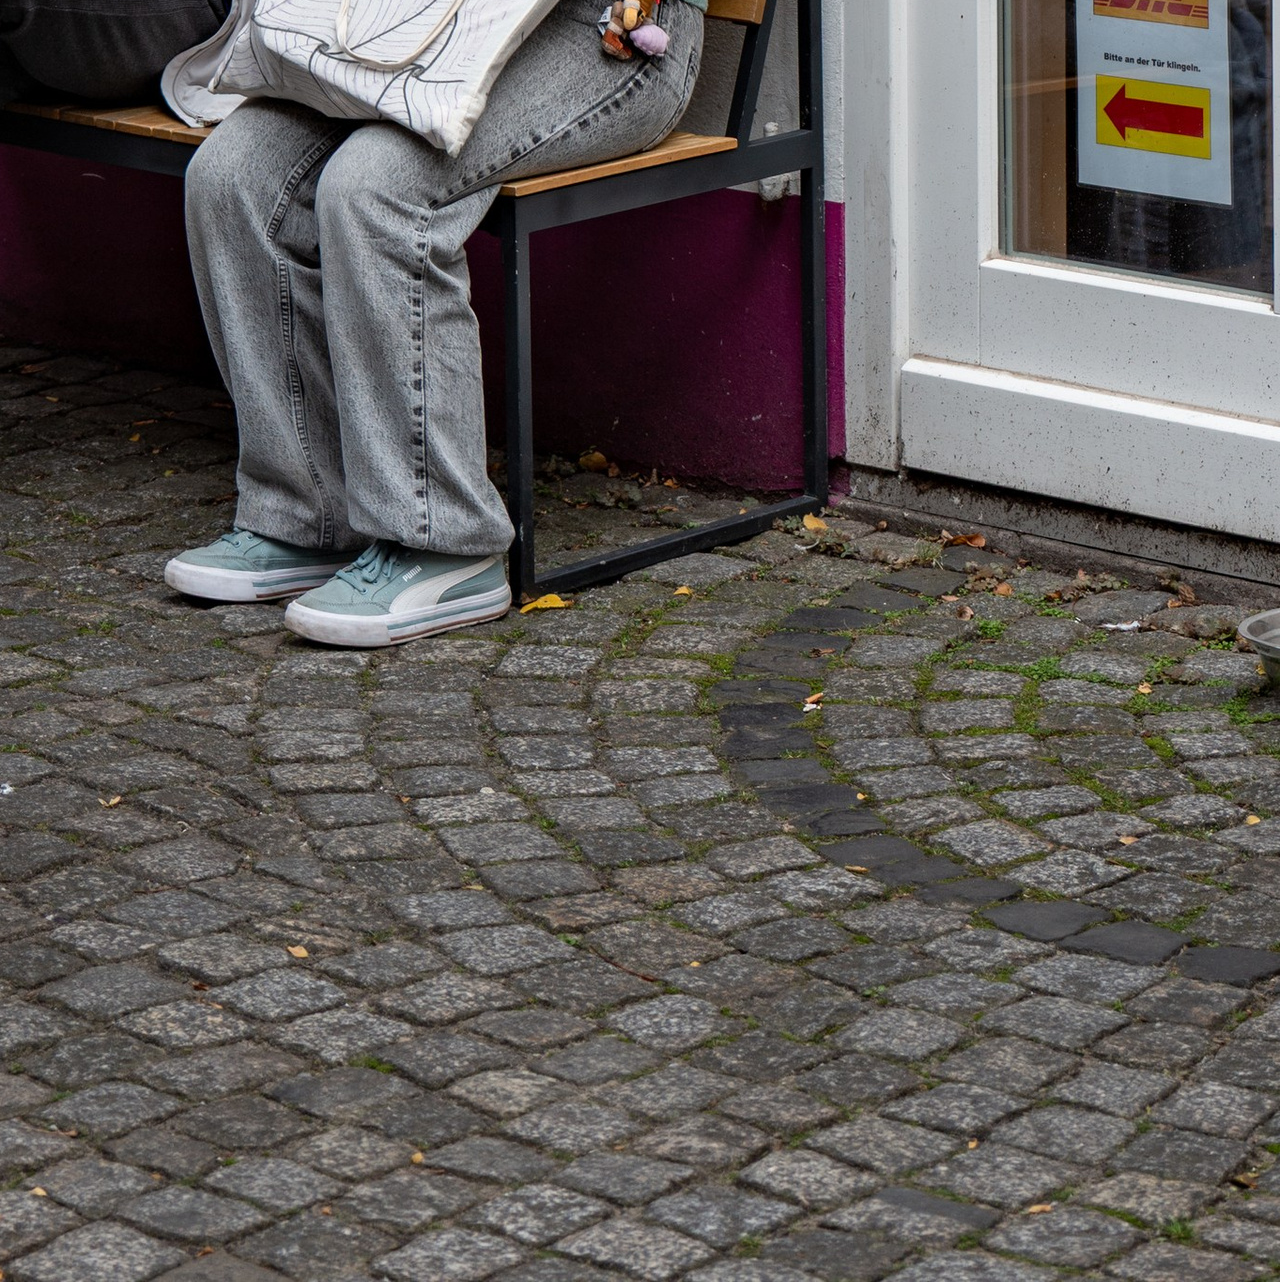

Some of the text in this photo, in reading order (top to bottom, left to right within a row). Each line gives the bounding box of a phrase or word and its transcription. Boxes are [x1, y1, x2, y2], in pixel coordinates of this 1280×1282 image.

[1104, 52, 1122, 62] Bitte
[1136, 57, 1149, 65] der
[1151, 58, 1165, 68] Tür
[1166, 61, 1201, 73] klingeln.
